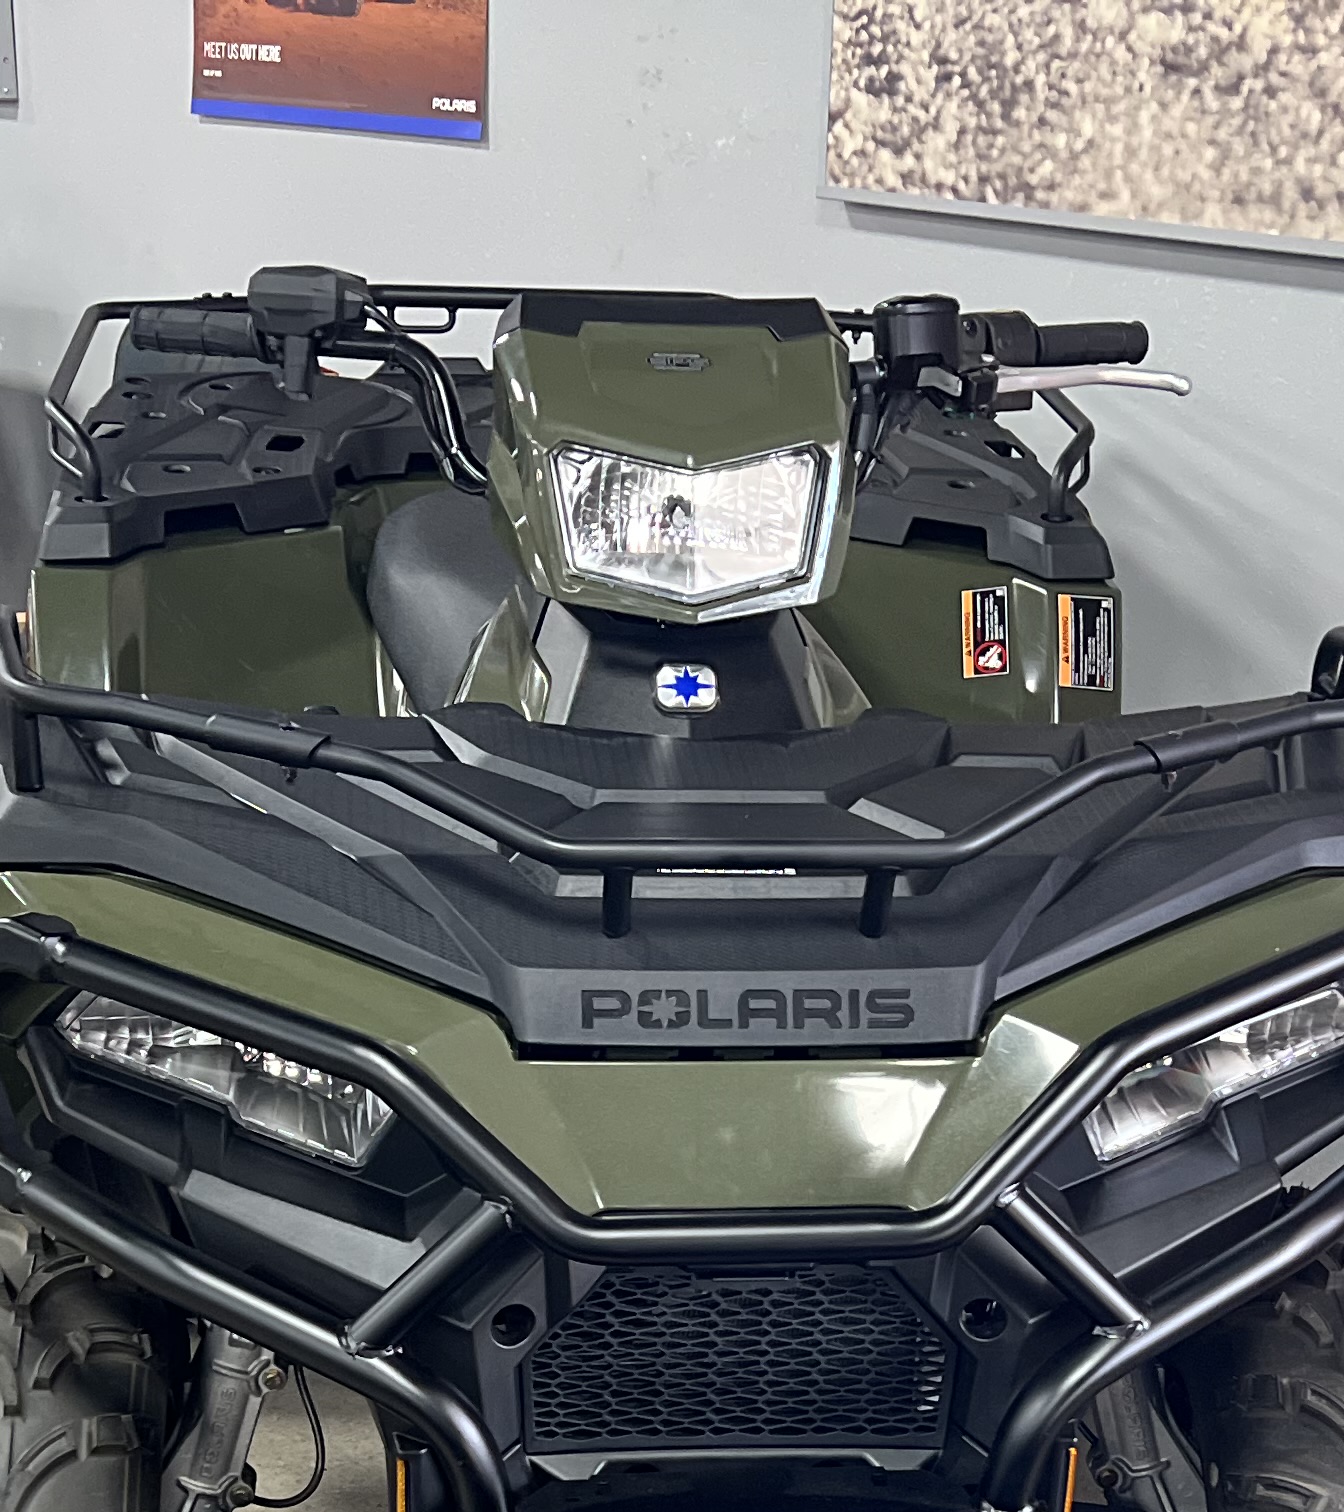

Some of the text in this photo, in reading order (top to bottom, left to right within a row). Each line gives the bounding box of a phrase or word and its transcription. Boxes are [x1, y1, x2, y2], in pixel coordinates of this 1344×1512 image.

[203, 41, 282, 63] MEET US OUT HERE
[432, 97, 476, 113] POLARIS
[580, 988, 915, 1030] POLARIS
